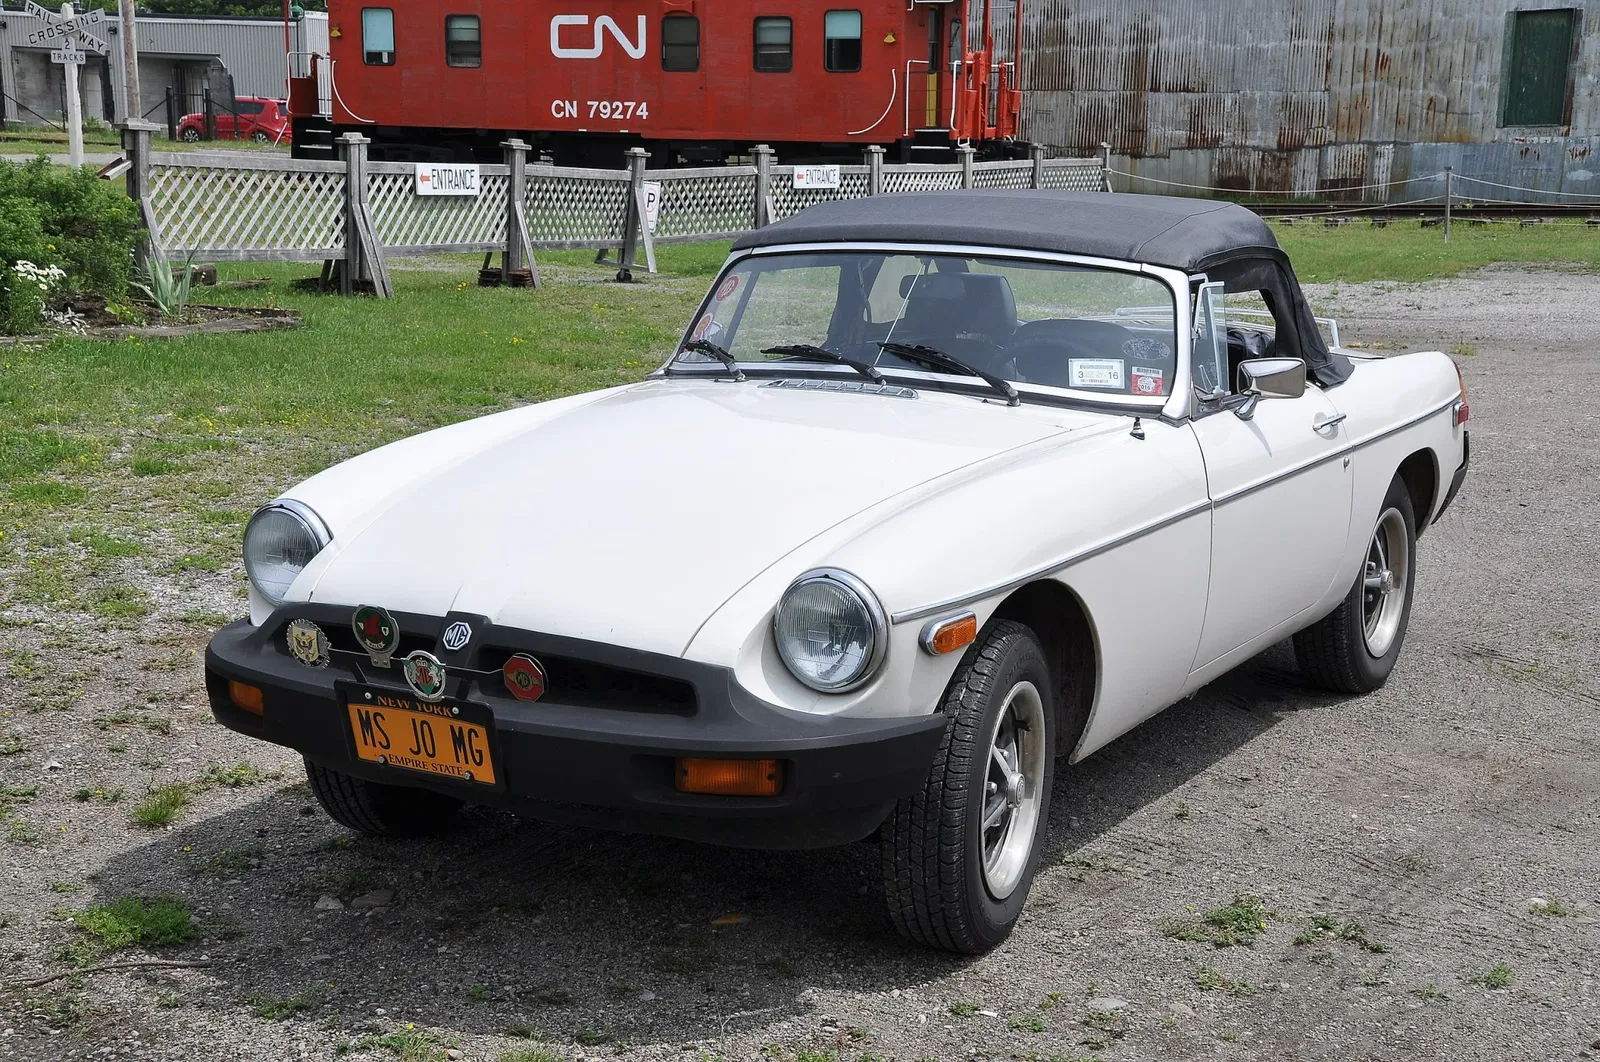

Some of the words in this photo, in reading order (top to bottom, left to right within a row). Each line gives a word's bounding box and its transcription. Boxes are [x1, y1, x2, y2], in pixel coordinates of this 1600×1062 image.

[27, 2, 53, 26] RAIL
[79, 31, 104, 52] WAY
[28, 12, 99, 45] CROSSING
[550, 14, 647, 59] CN
[64, 38, 71, 50] 2
[52, 53, 85, 62] TRACKS
[551, 100, 578, 118] CN
[587, 101, 649, 120] 79274
[431, 168, 476, 190] ENTRANCE
[805, 168, 837, 185] ENTRANCE
[646, 192, 656, 208] P
[1077, 370, 1085, 379] 3
[1108, 371, 1119, 380] 16
[445, 624, 468, 647] MG
[377, 696, 410, 709] NEW
[415, 702, 454, 718] YORK
[356, 708, 391, 750] MS
[449, 724, 484, 767] MG
[388, 753, 429, 770] EMPIRE
[431, 763, 465, 777] STATE
